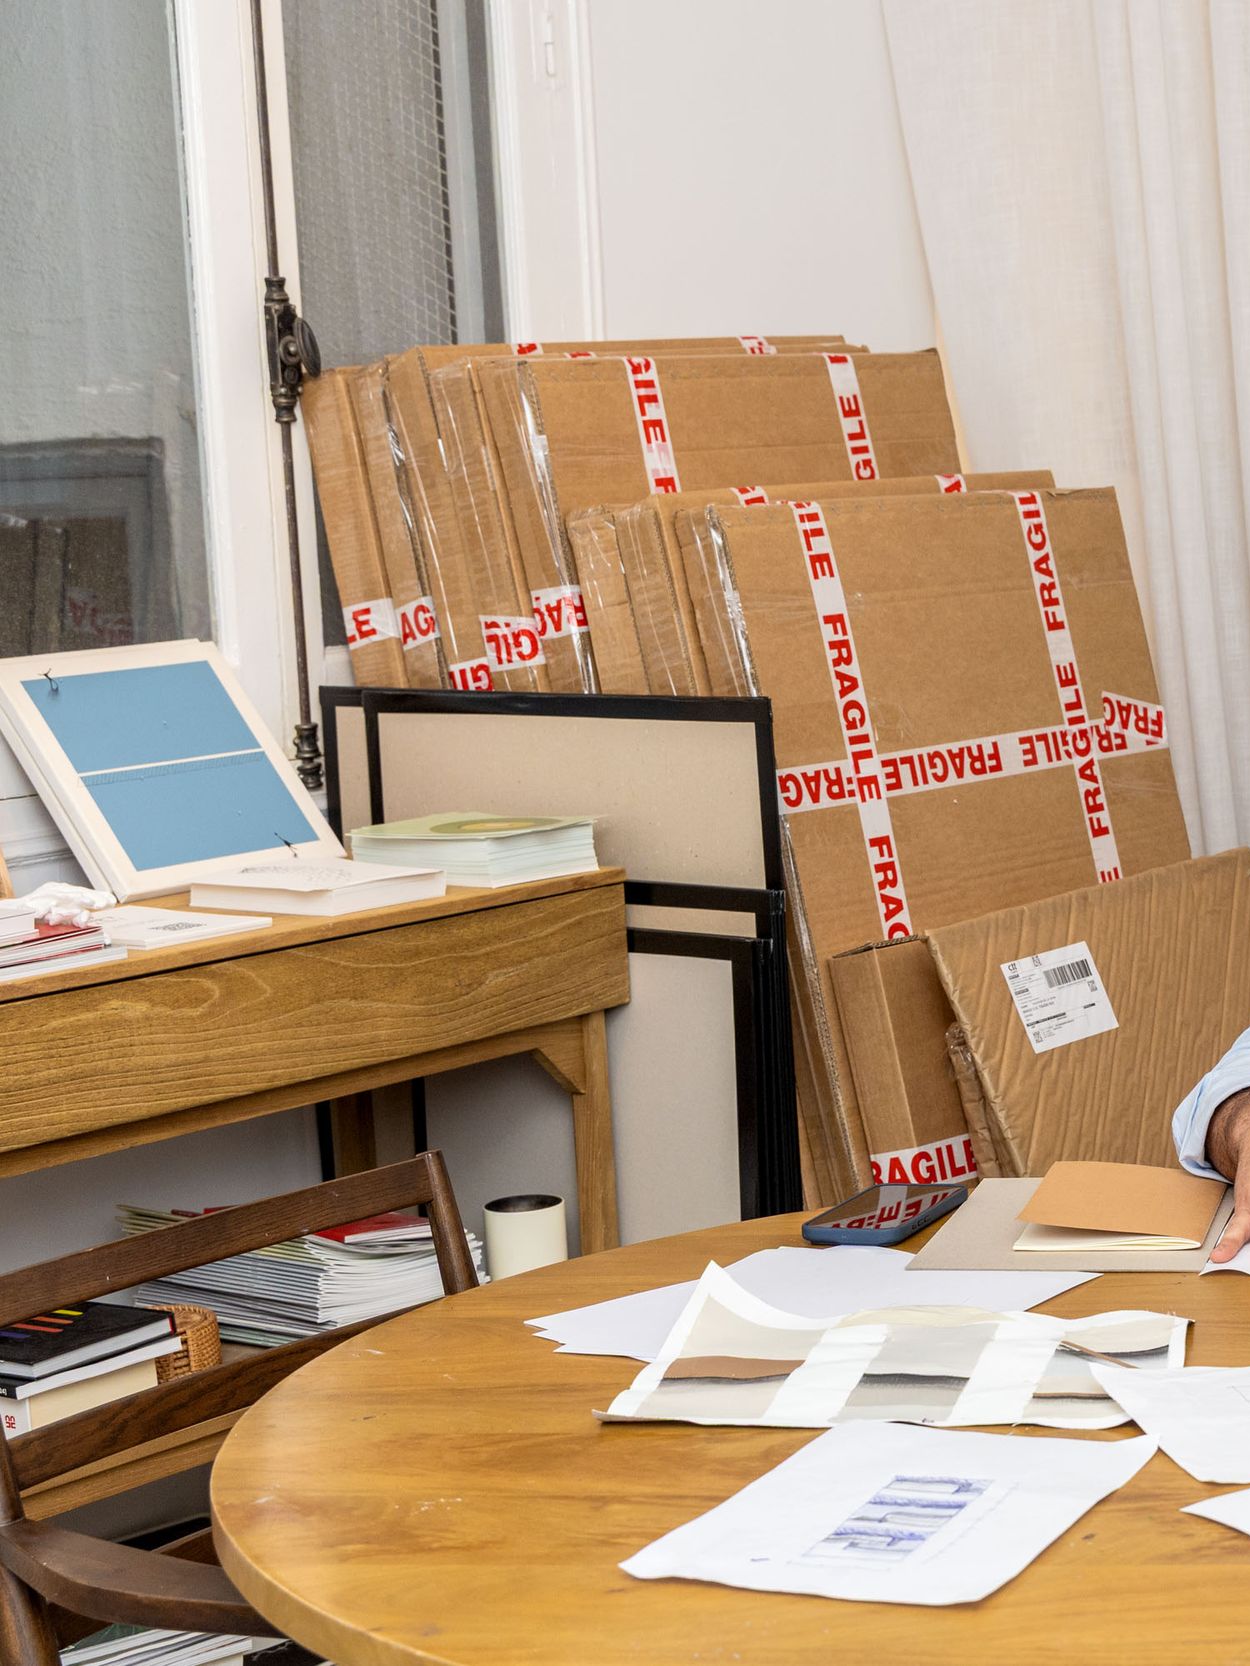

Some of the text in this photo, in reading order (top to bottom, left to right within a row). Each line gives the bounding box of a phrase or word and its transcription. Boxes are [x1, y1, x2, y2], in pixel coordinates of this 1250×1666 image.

[823, 613, 882, 803] FRAGILE
[881, 742, 1003, 791] FRAGILE
[1055, 662, 1110, 838] FRAGILE
